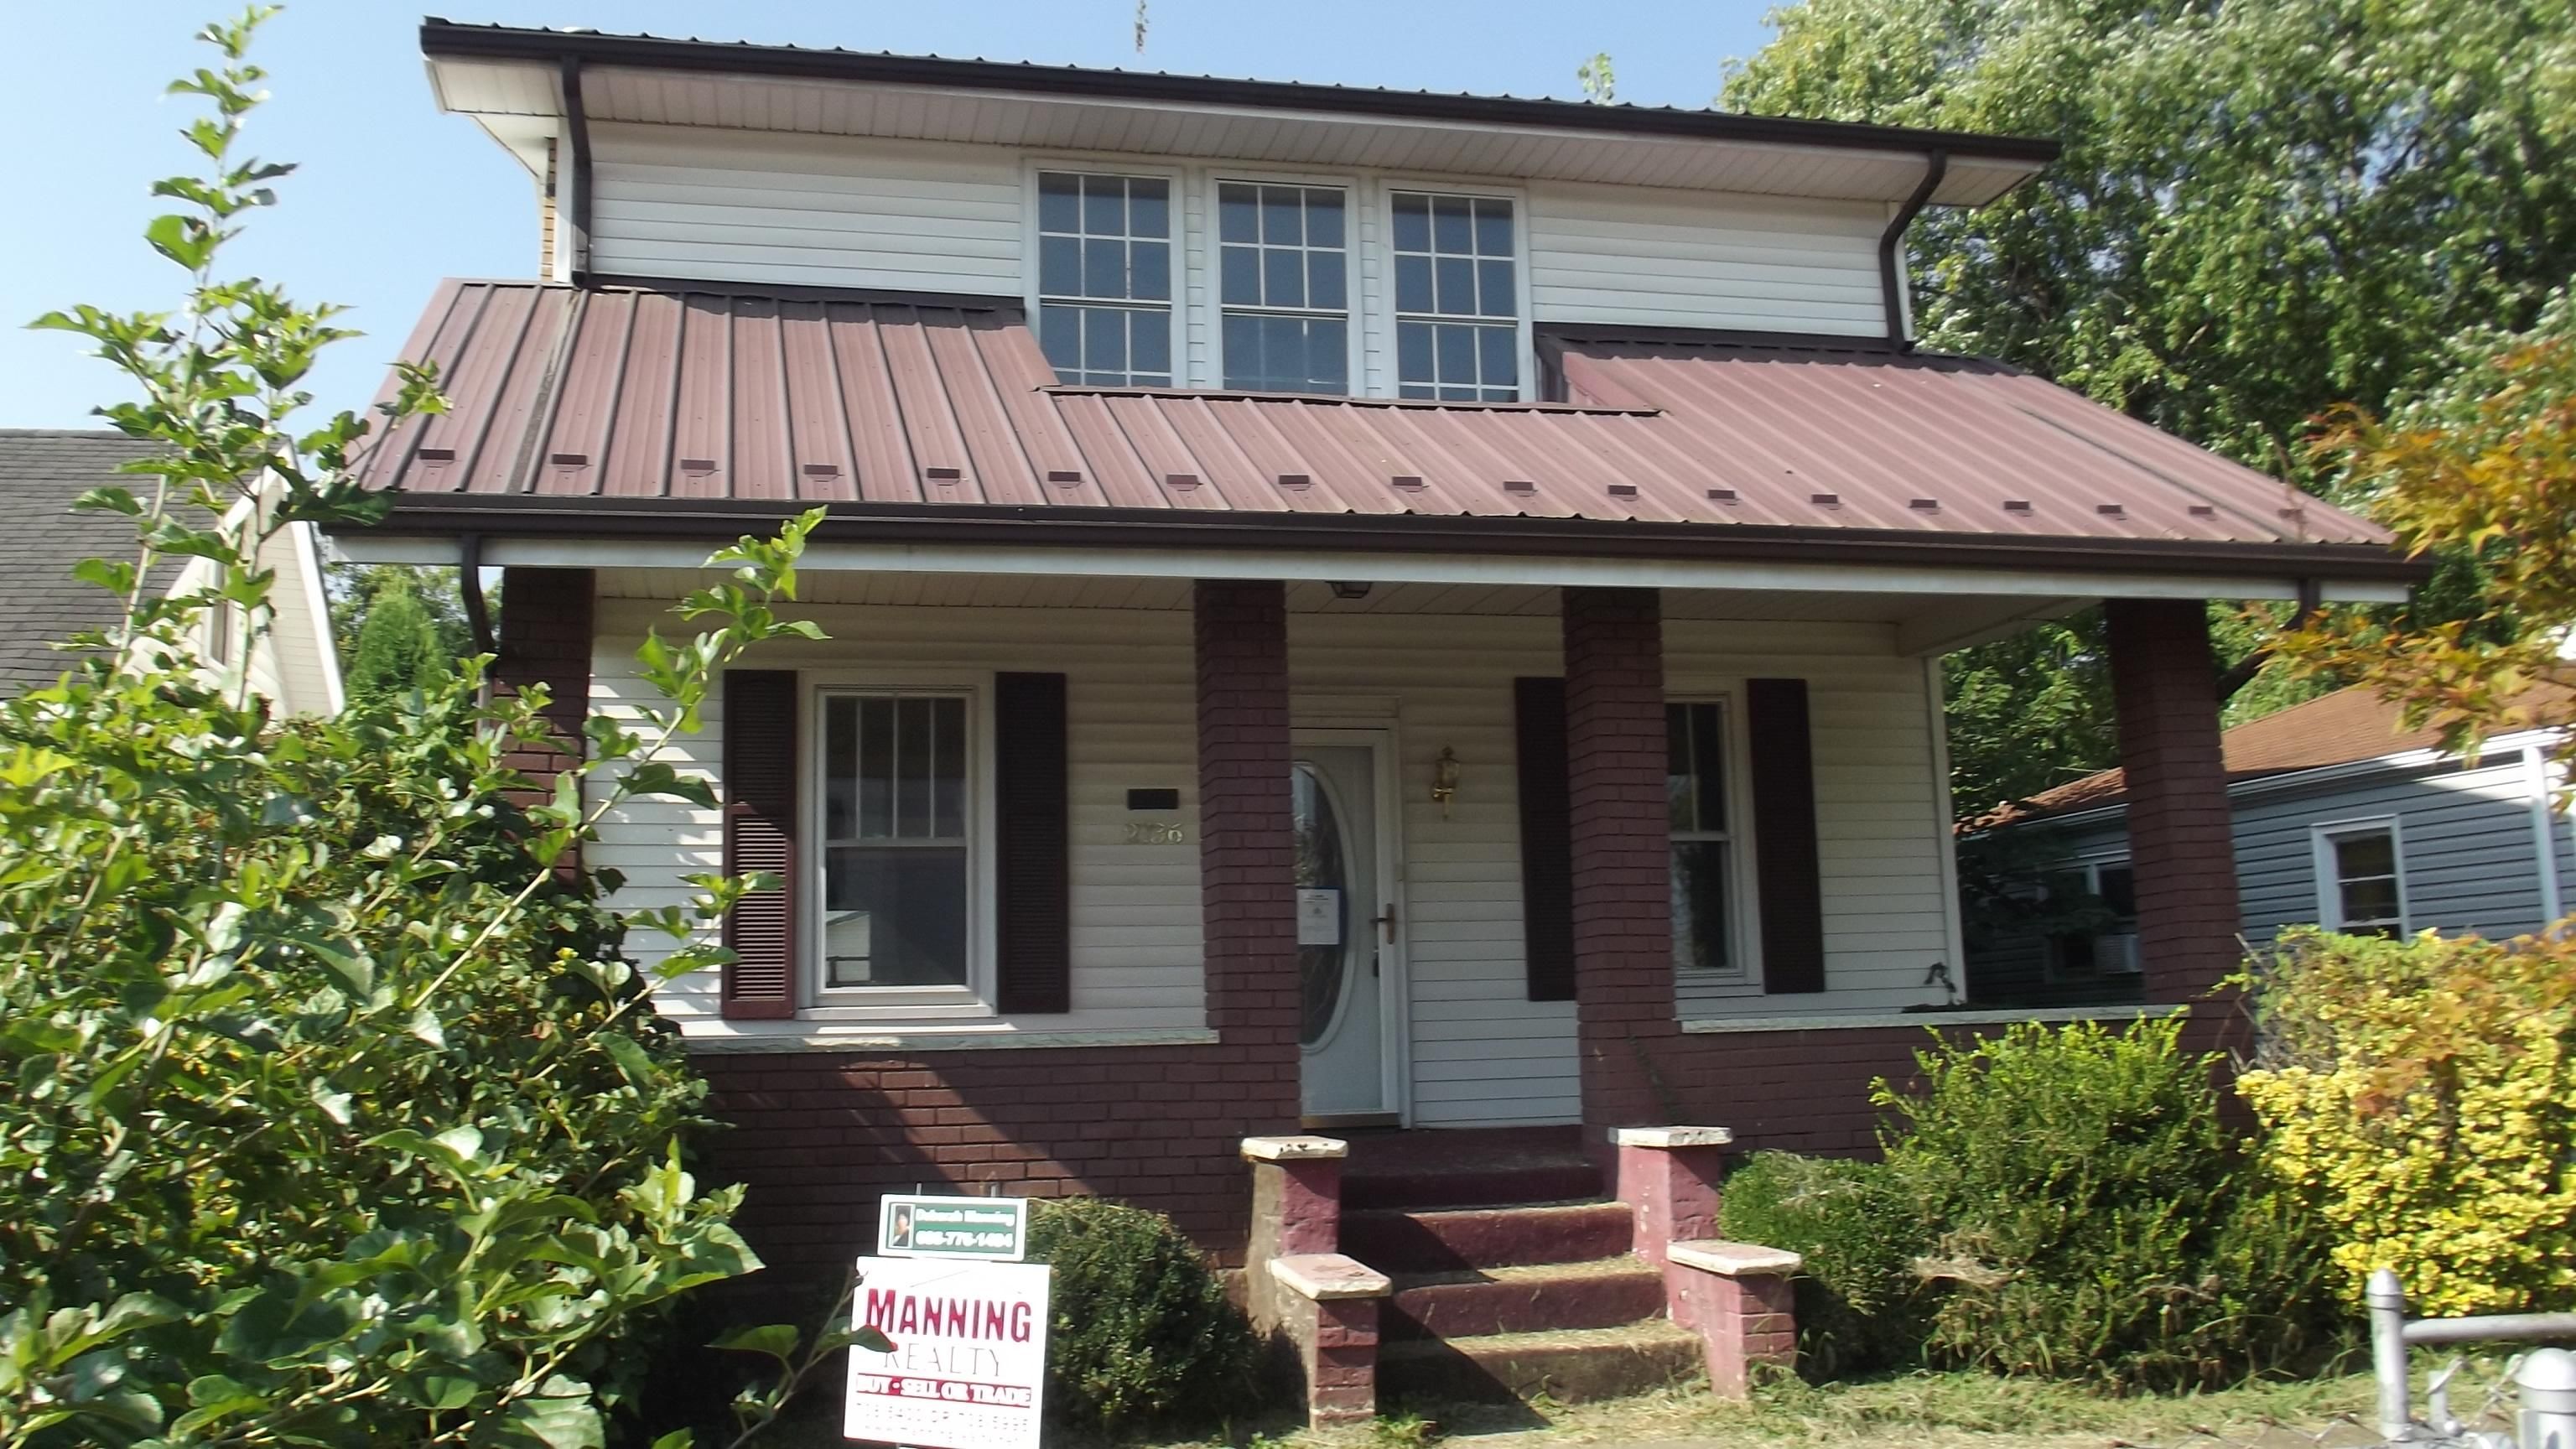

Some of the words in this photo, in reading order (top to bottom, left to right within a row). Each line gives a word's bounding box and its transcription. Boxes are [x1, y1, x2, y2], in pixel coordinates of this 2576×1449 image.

[866, 1288, 1031, 1343] MANNING
[856, 1374, 893, 1394] UY
[970, 1384, 1031, 1405] TRADE
